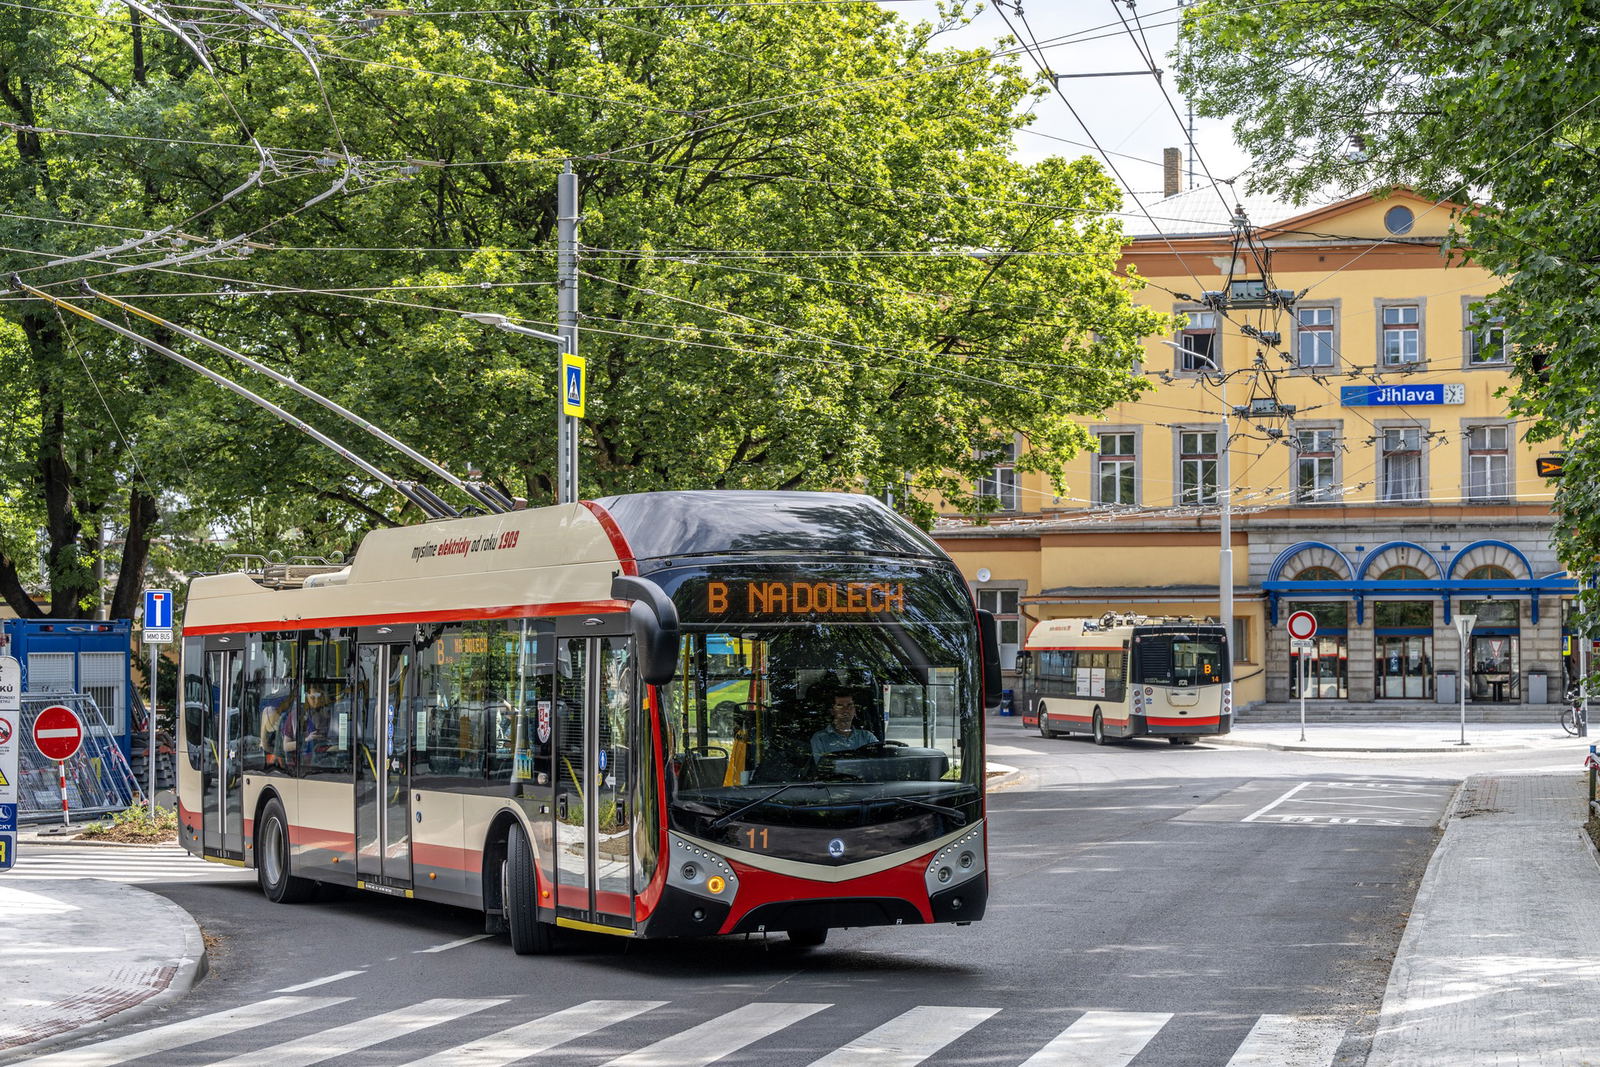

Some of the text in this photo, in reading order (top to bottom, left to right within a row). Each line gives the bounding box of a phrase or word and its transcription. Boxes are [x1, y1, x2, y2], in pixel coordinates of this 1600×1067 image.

[1376, 388, 1435, 402] Jihlava
[411, 530, 520, 563] myslíme elektricky od roku 1909
[708, 582, 729, 613] B
[437, 639, 445, 665] B
[1204, 664, 1212, 674] B
[746, 828, 769, 849] 11
